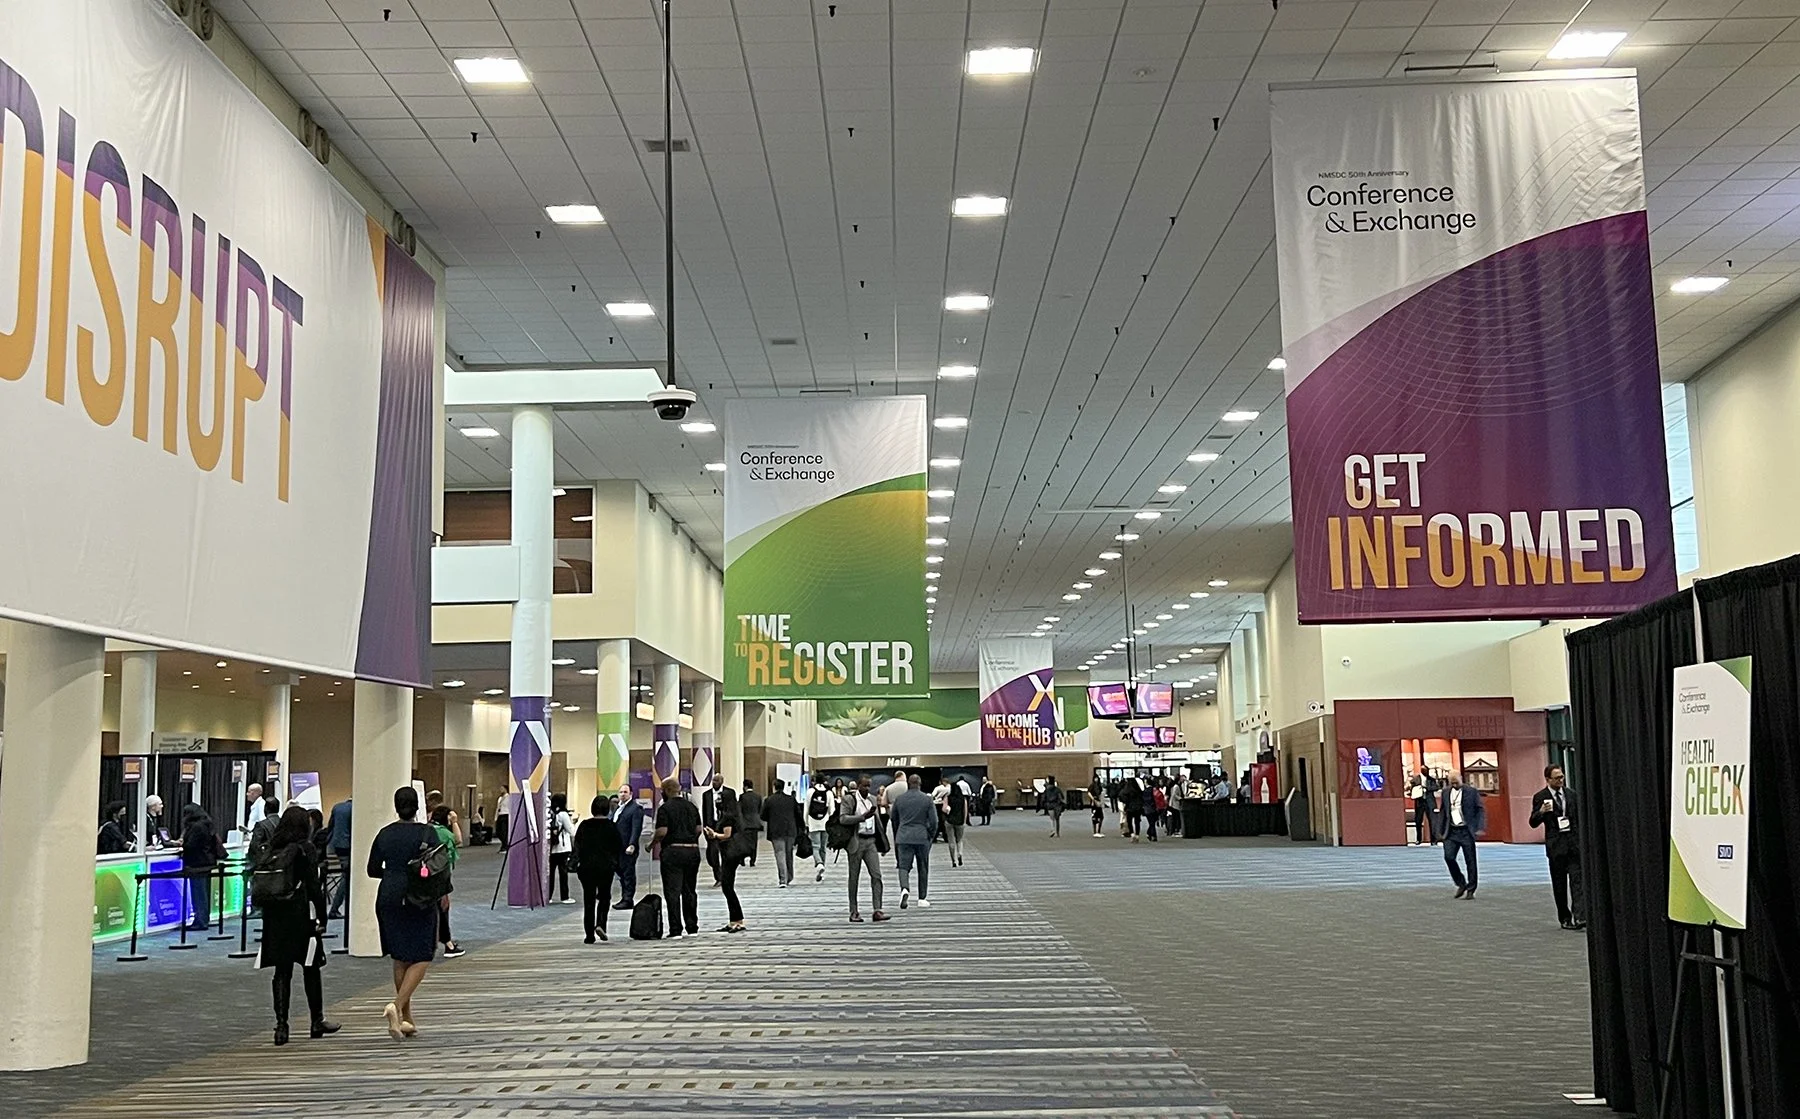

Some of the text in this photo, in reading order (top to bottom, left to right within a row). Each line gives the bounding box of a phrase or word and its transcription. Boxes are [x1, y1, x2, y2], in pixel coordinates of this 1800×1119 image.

[1367, 169, 1409, 178] Anniversary
[1307, 182, 1454, 207] Conference
[1325, 208, 1476, 235] & Exchange
[0, 58, 304, 503] DISRUPT
[740, 451, 823, 465] Conference
[749, 467, 835, 484] & Exchange
[1344, 453, 1426, 509] GET
[1328, 508, 1647, 591] INFORMED
[737, 614, 791, 642] TIME
[733, 641, 914, 686] TO REGISTER
[985, 713, 1039, 728] WELCOME
[995, 727, 1051, 746] TO THE HUB
[886, 757, 907, 767] Hall
[1680, 739, 1714, 765] HEALTH
[1685, 764, 1745, 816] CHECK
